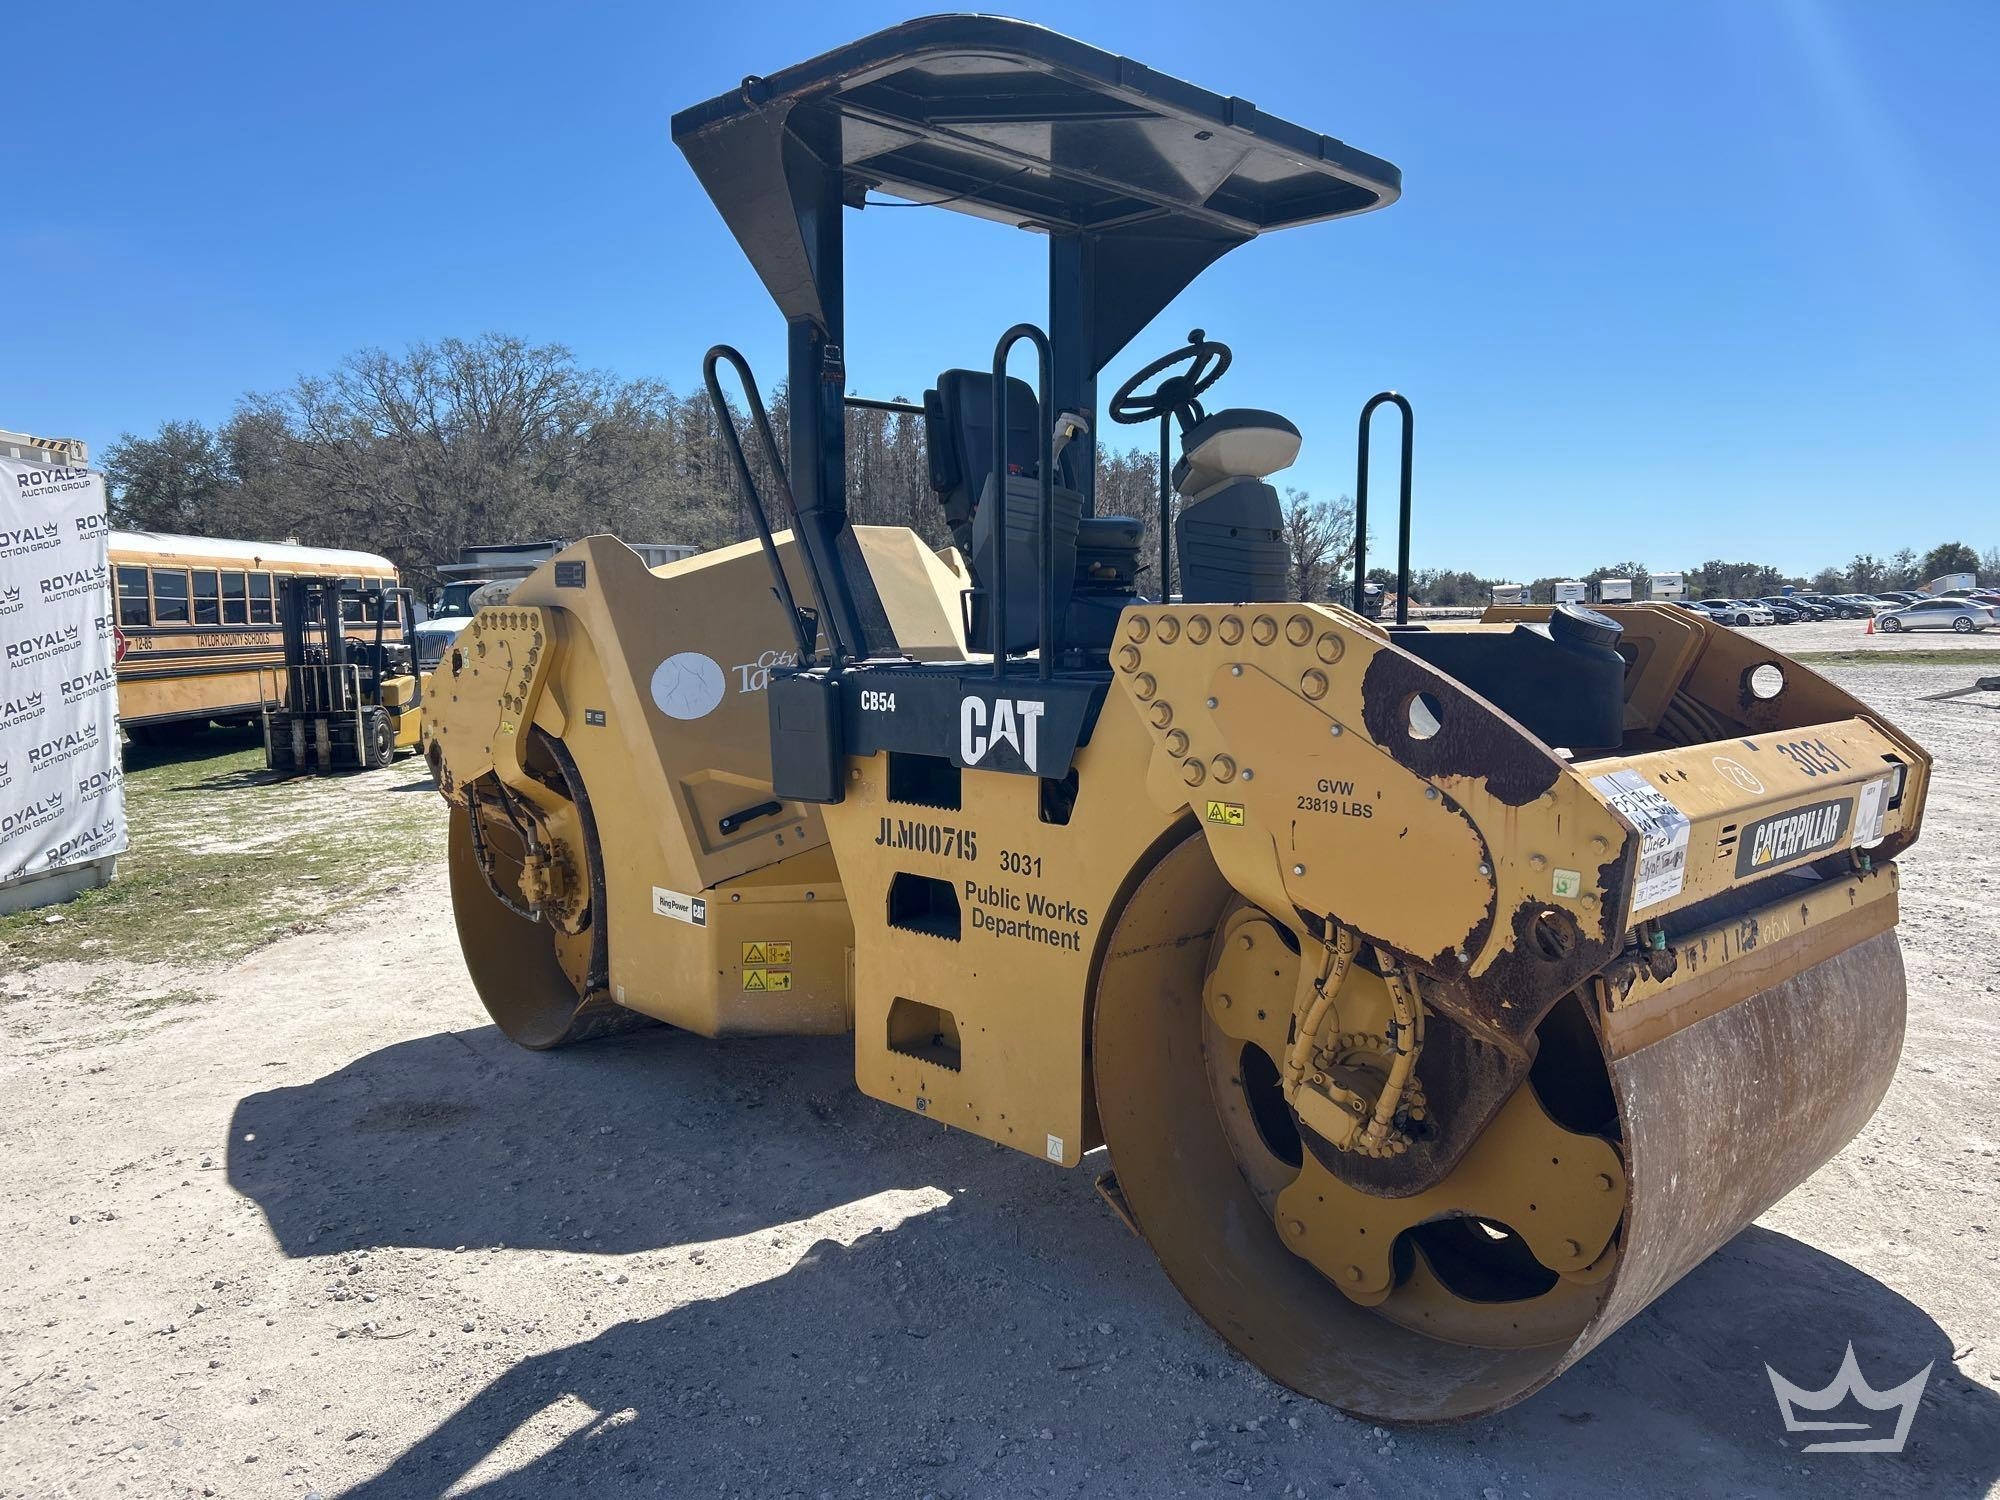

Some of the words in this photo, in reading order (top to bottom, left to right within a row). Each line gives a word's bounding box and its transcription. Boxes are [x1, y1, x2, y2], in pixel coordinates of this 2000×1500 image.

[17, 468, 75, 488] ROYAL
[21, 485, 61, 498] AUCTION
[61, 480, 91, 492] GROUP
[30, 539, 62, 552] GROUP
[40, 569, 94, 593] ROYAL
[44, 587, 80, 604] AUCTION
[81, 580, 108, 593] GROU
[6, 631, 65, 659] ROYAL
[196, 634, 220, 647] TAYLOR
[220, 633, 244, 647] COUNTY
[244, 632, 270, 645] SCHOOLS
[10, 650, 51, 669] AUCTION
[52, 640, 82, 655] GROUP
[757, 650, 797, 669] City
[60, 667, 112, 696] ROYAL
[64, 687, 99, 705] AUCTION
[861, 690, 896, 712] CB54
[13, 707, 46, 725] GROUP
[960, 695, 1045, 773] CAT
[28, 731, 85, 763] ROYAL
[32, 750, 72, 774] AUCTION
[72, 738, 100, 756] GROUP
[1776, 738, 1851, 777] 3031
[1317, 778, 1354, 796] GVW
[33, 807, 65, 828] GROUP
[1297, 795, 1338, 814] 23819
[1342, 801, 1373, 819] LBS
[46, 827, 103, 863] ROYAL
[89, 832, 117, 852] GROUP
[874, 817, 978, 861] JLM00715
[1751, 803, 1841, 867] CATERPILLAR
[999, 850, 1042, 878] 3031
[659, 896, 671, 910] Ring
[671, 900, 689, 913] Power
[693, 904, 705, 919] CAT
[965, 880, 1021, 911] Public
[1025, 892, 1089, 926] Works
[972, 907, 1080, 951] Department
